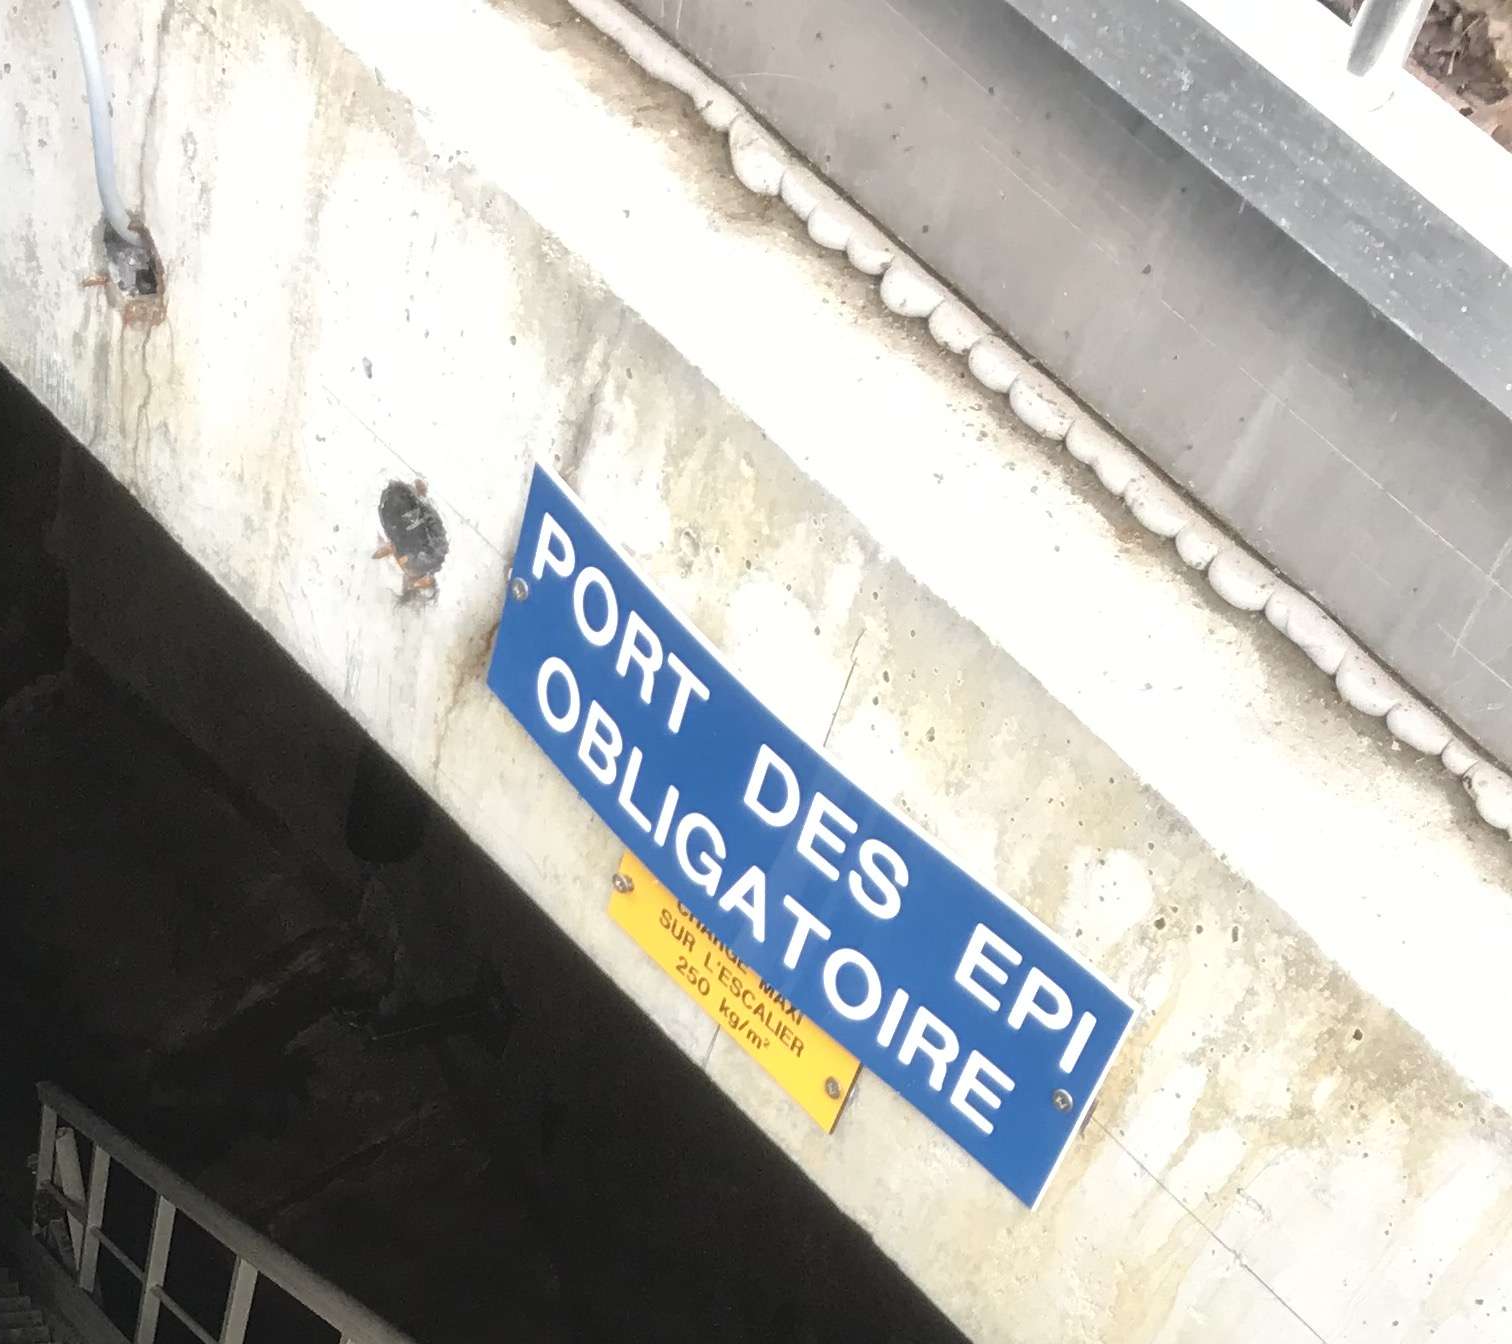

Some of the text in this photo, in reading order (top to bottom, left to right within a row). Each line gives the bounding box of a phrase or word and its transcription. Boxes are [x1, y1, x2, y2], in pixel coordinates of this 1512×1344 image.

[531, 510, 1098, 1075] PORT DES EPI
[535, 655, 1016, 1135] OBLIGATOIRE
[658, 908, 805, 1058] SUR L'ESCALIER
[675, 955, 711, 996] 250
[758, 981, 805, 1026] MAXI
